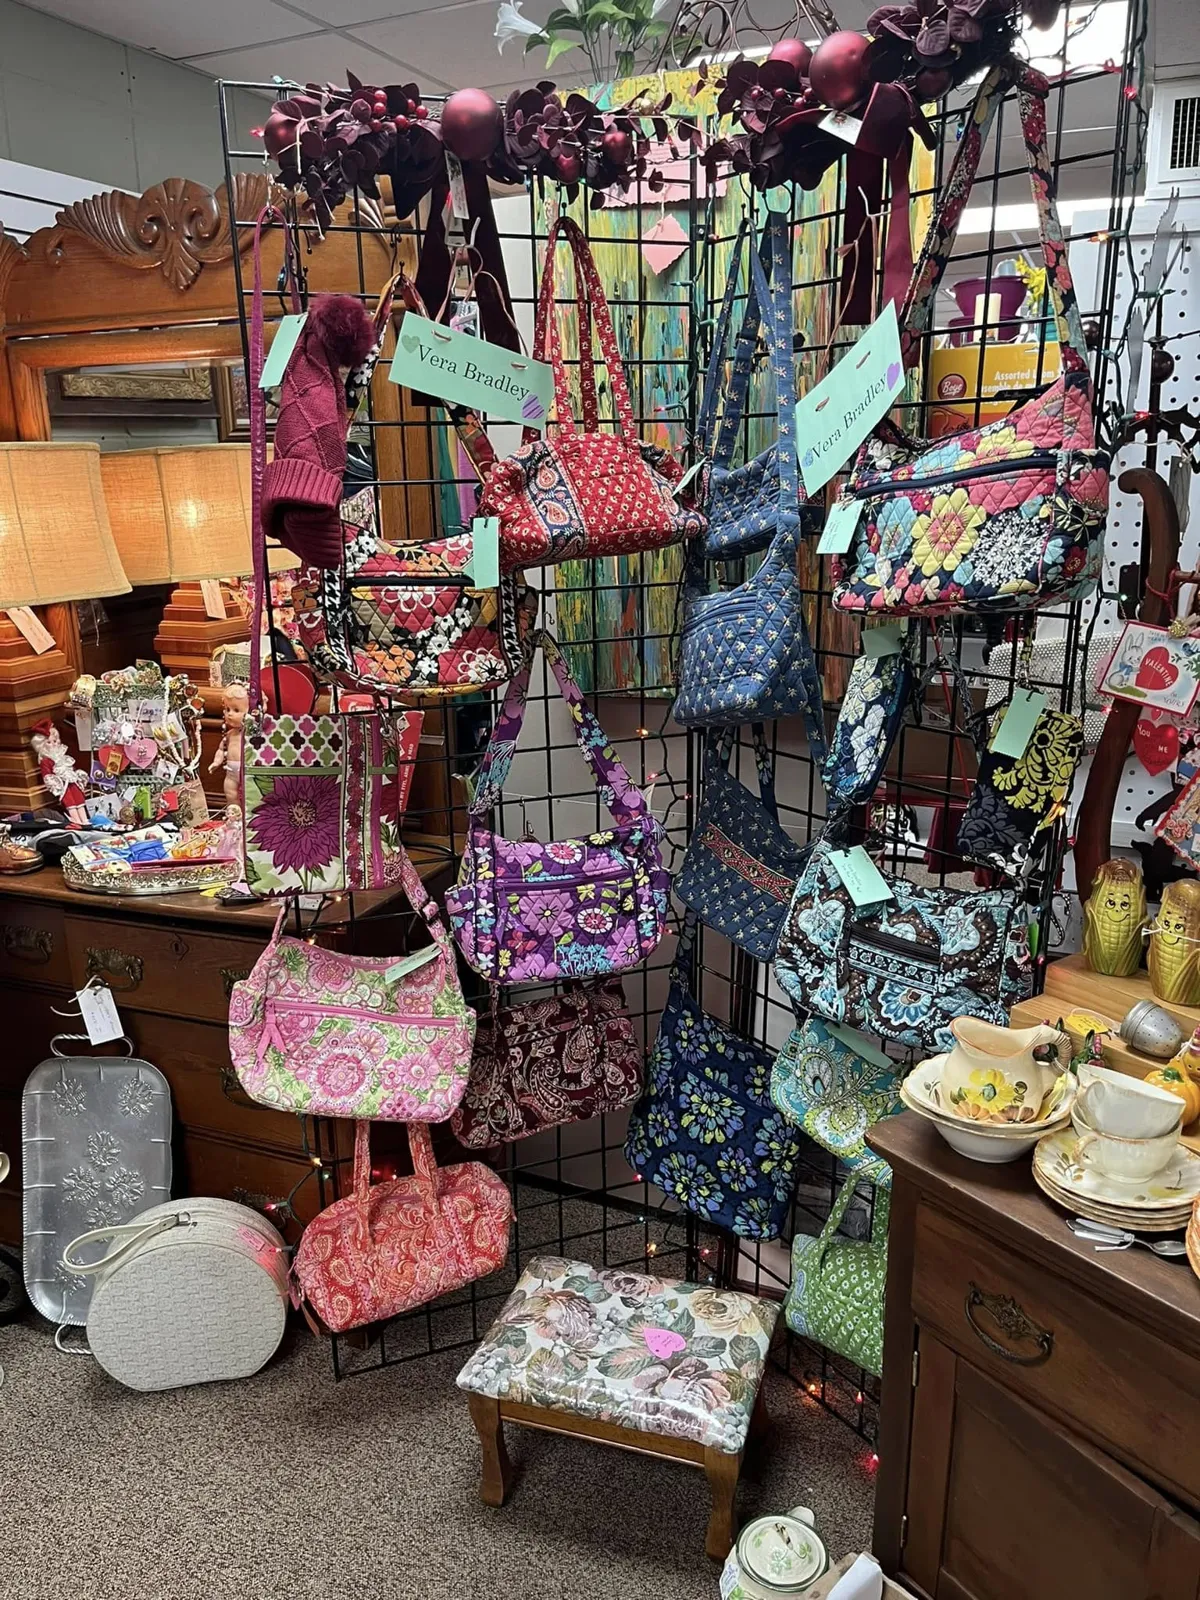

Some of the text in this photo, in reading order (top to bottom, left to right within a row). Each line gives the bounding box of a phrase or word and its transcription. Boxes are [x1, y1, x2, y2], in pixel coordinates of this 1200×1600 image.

[418, 343, 530, 401] Vera Bradley
[994, 369, 1055, 380] Assorted Lom
[811, 373, 888, 459] Vera Bradley
[1144, 657, 1173, 687] VALENTINE
[1158, 745, 1169, 754] ME
